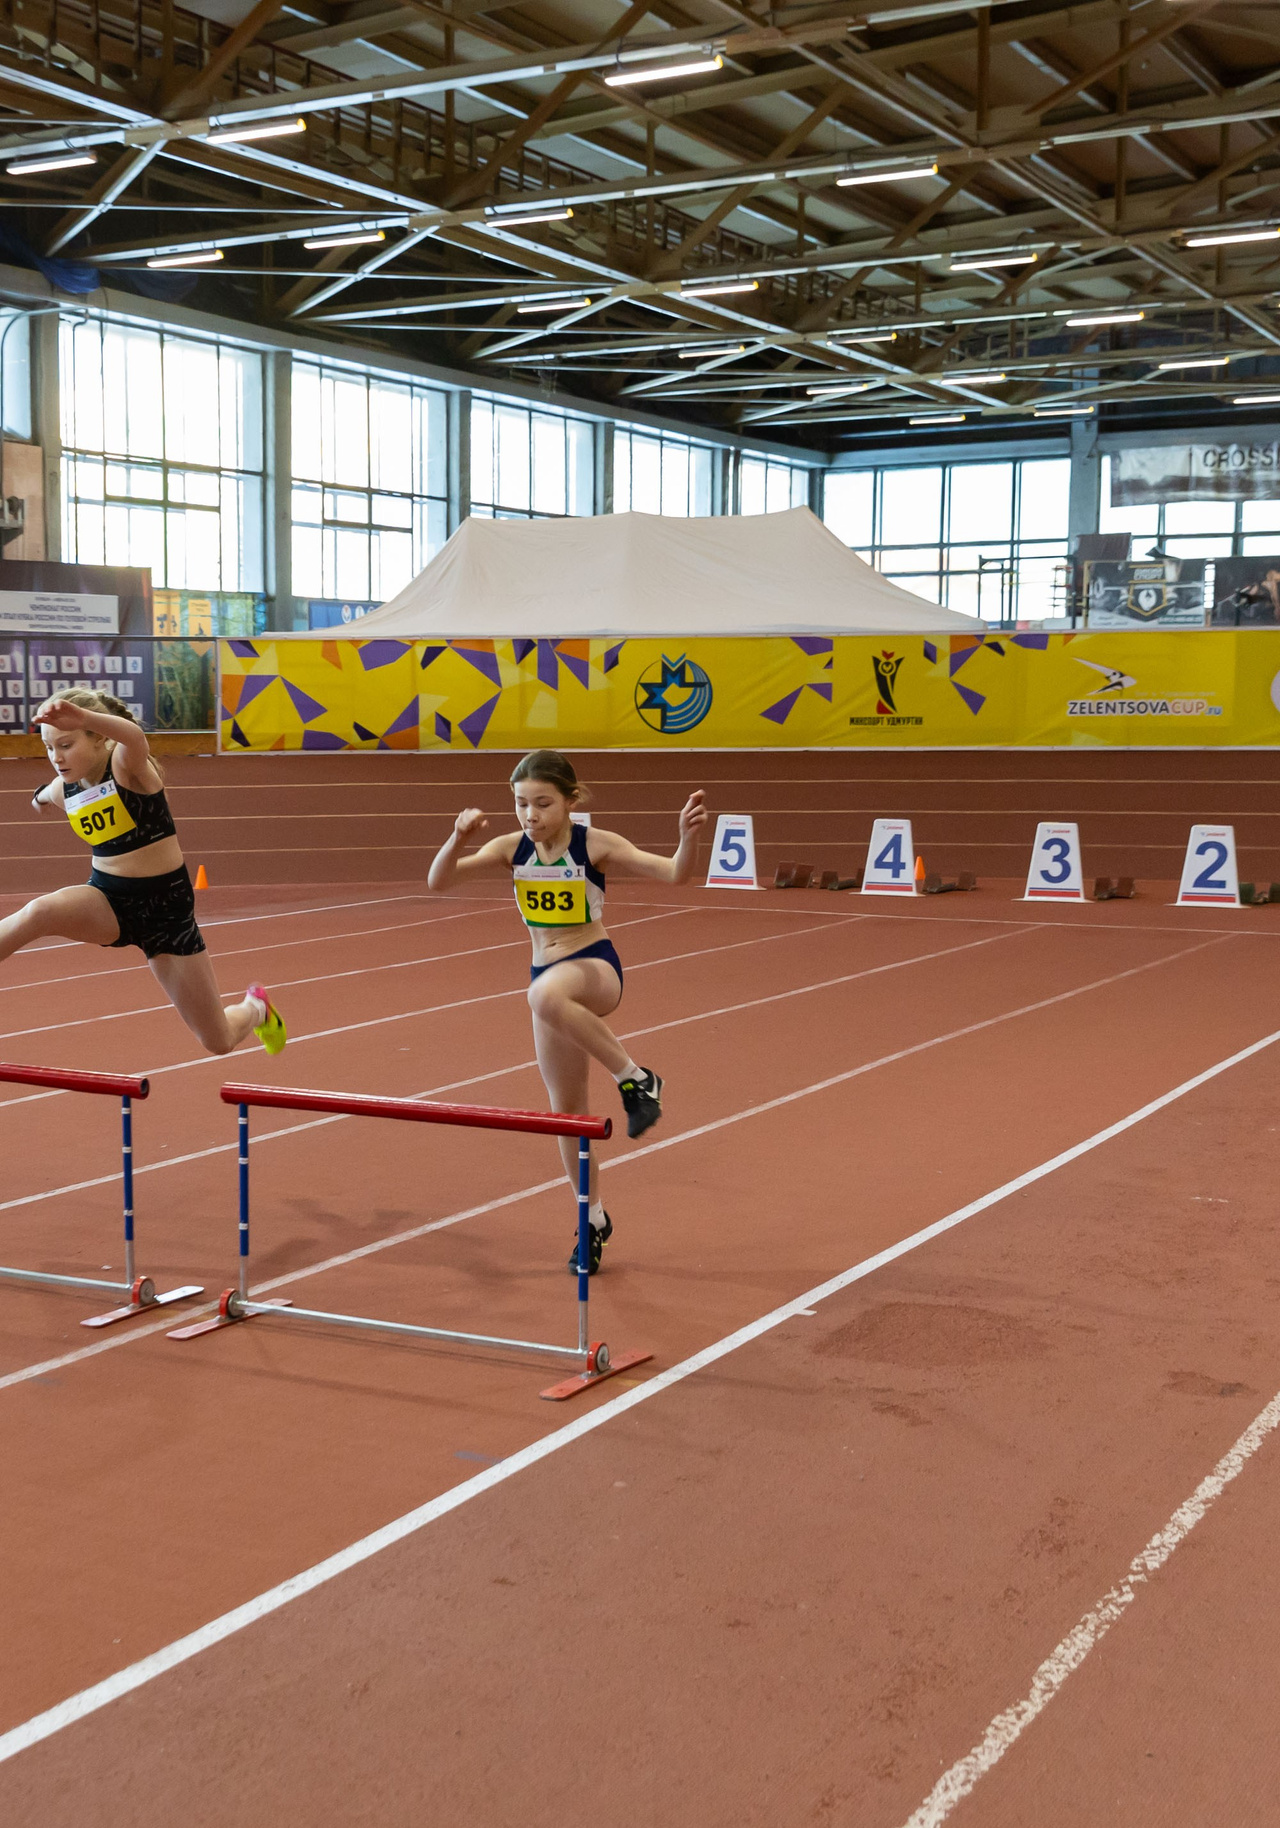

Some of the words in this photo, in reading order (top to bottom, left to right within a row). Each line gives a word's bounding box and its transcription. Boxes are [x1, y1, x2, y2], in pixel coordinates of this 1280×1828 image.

[1203, 448, 1280, 468] CROSS
[80, 805, 116, 836] 507
[719, 829, 747, 872] 5
[874, 834, 906, 878] 4
[1040, 837, 1072, 884] 3
[1192, 841, 1228, 889] 2
[526, 890, 574, 911] 583
